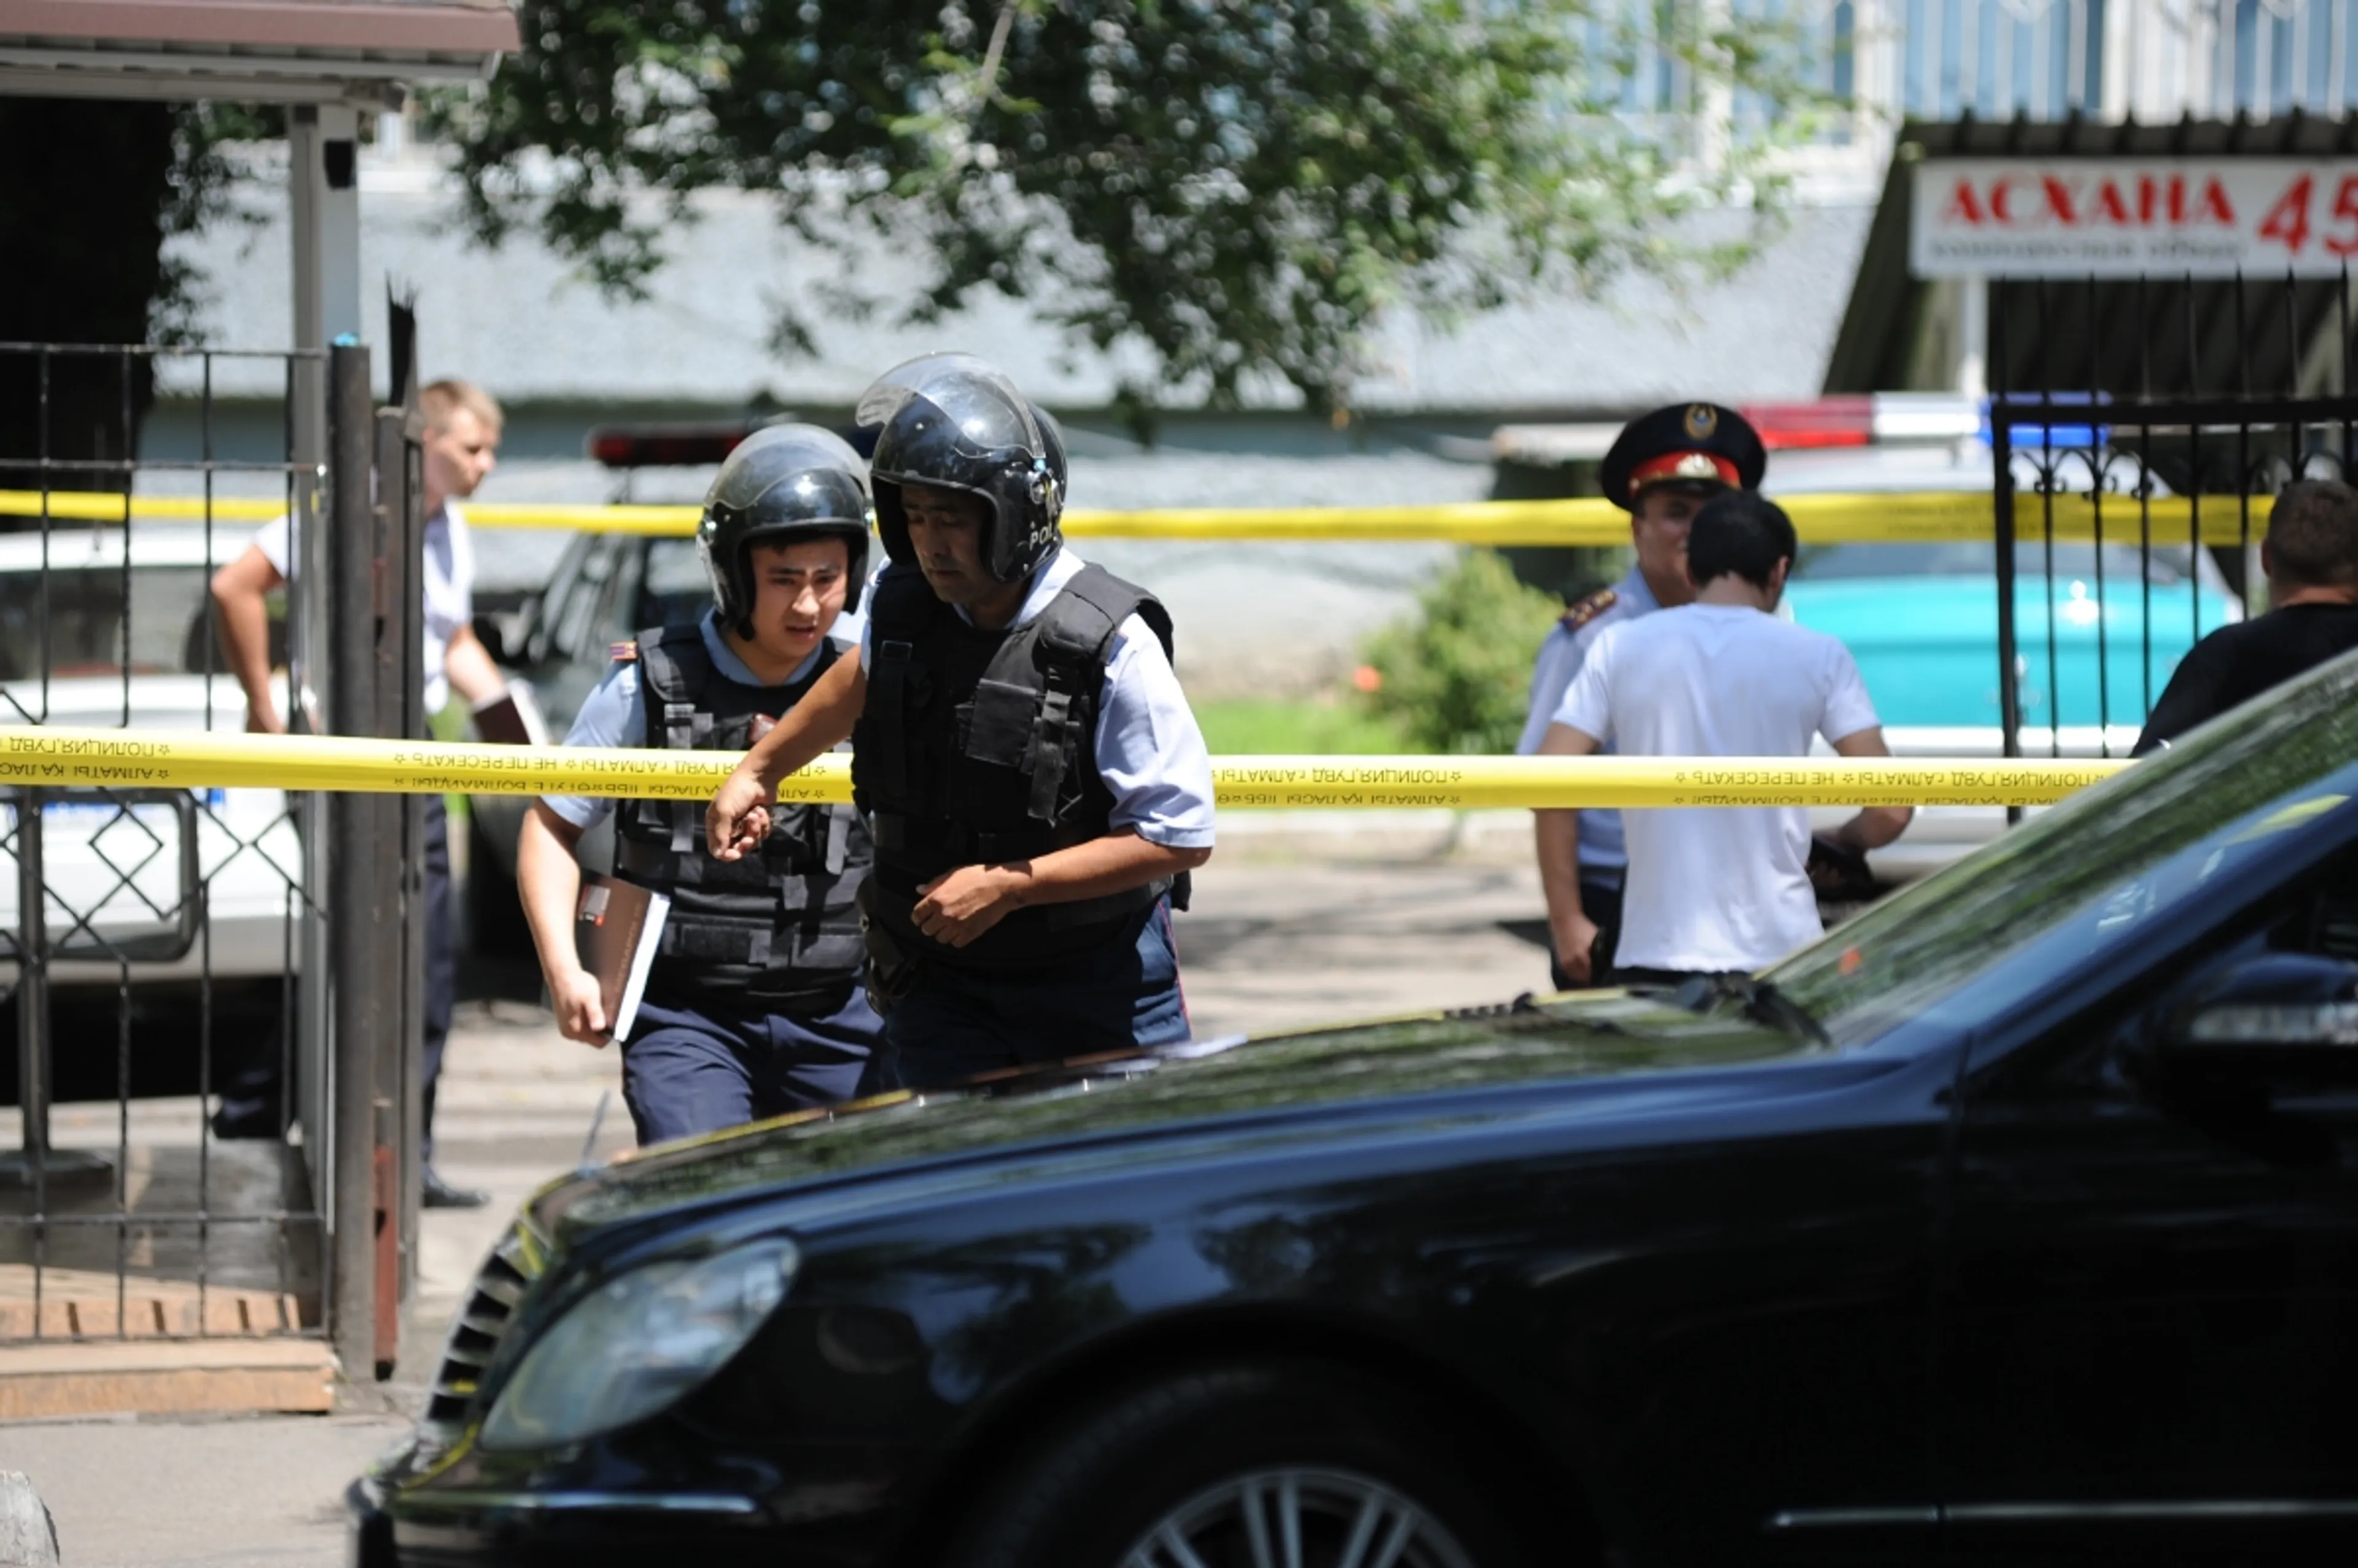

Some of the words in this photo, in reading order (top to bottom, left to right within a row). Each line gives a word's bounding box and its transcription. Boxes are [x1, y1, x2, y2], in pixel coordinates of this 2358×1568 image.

[1029, 523, 1053, 551] POL
[413, 753, 527, 770] ПЕРЕСЕКАТЬ
[534, 758, 557, 770] НЕ
[0, 763, 64, 777] ҚАЛАС
[74, 766, 153, 779] АЛМАТЫ
[1693, 770, 1806, 785] ПЕРЕСЕКАТЬ
[1811, 772, 1835, 785] НЕ
[648, 785, 720, 797] АЛАСЫ
[1371, 795, 1446, 805] АЛМАТЫ
